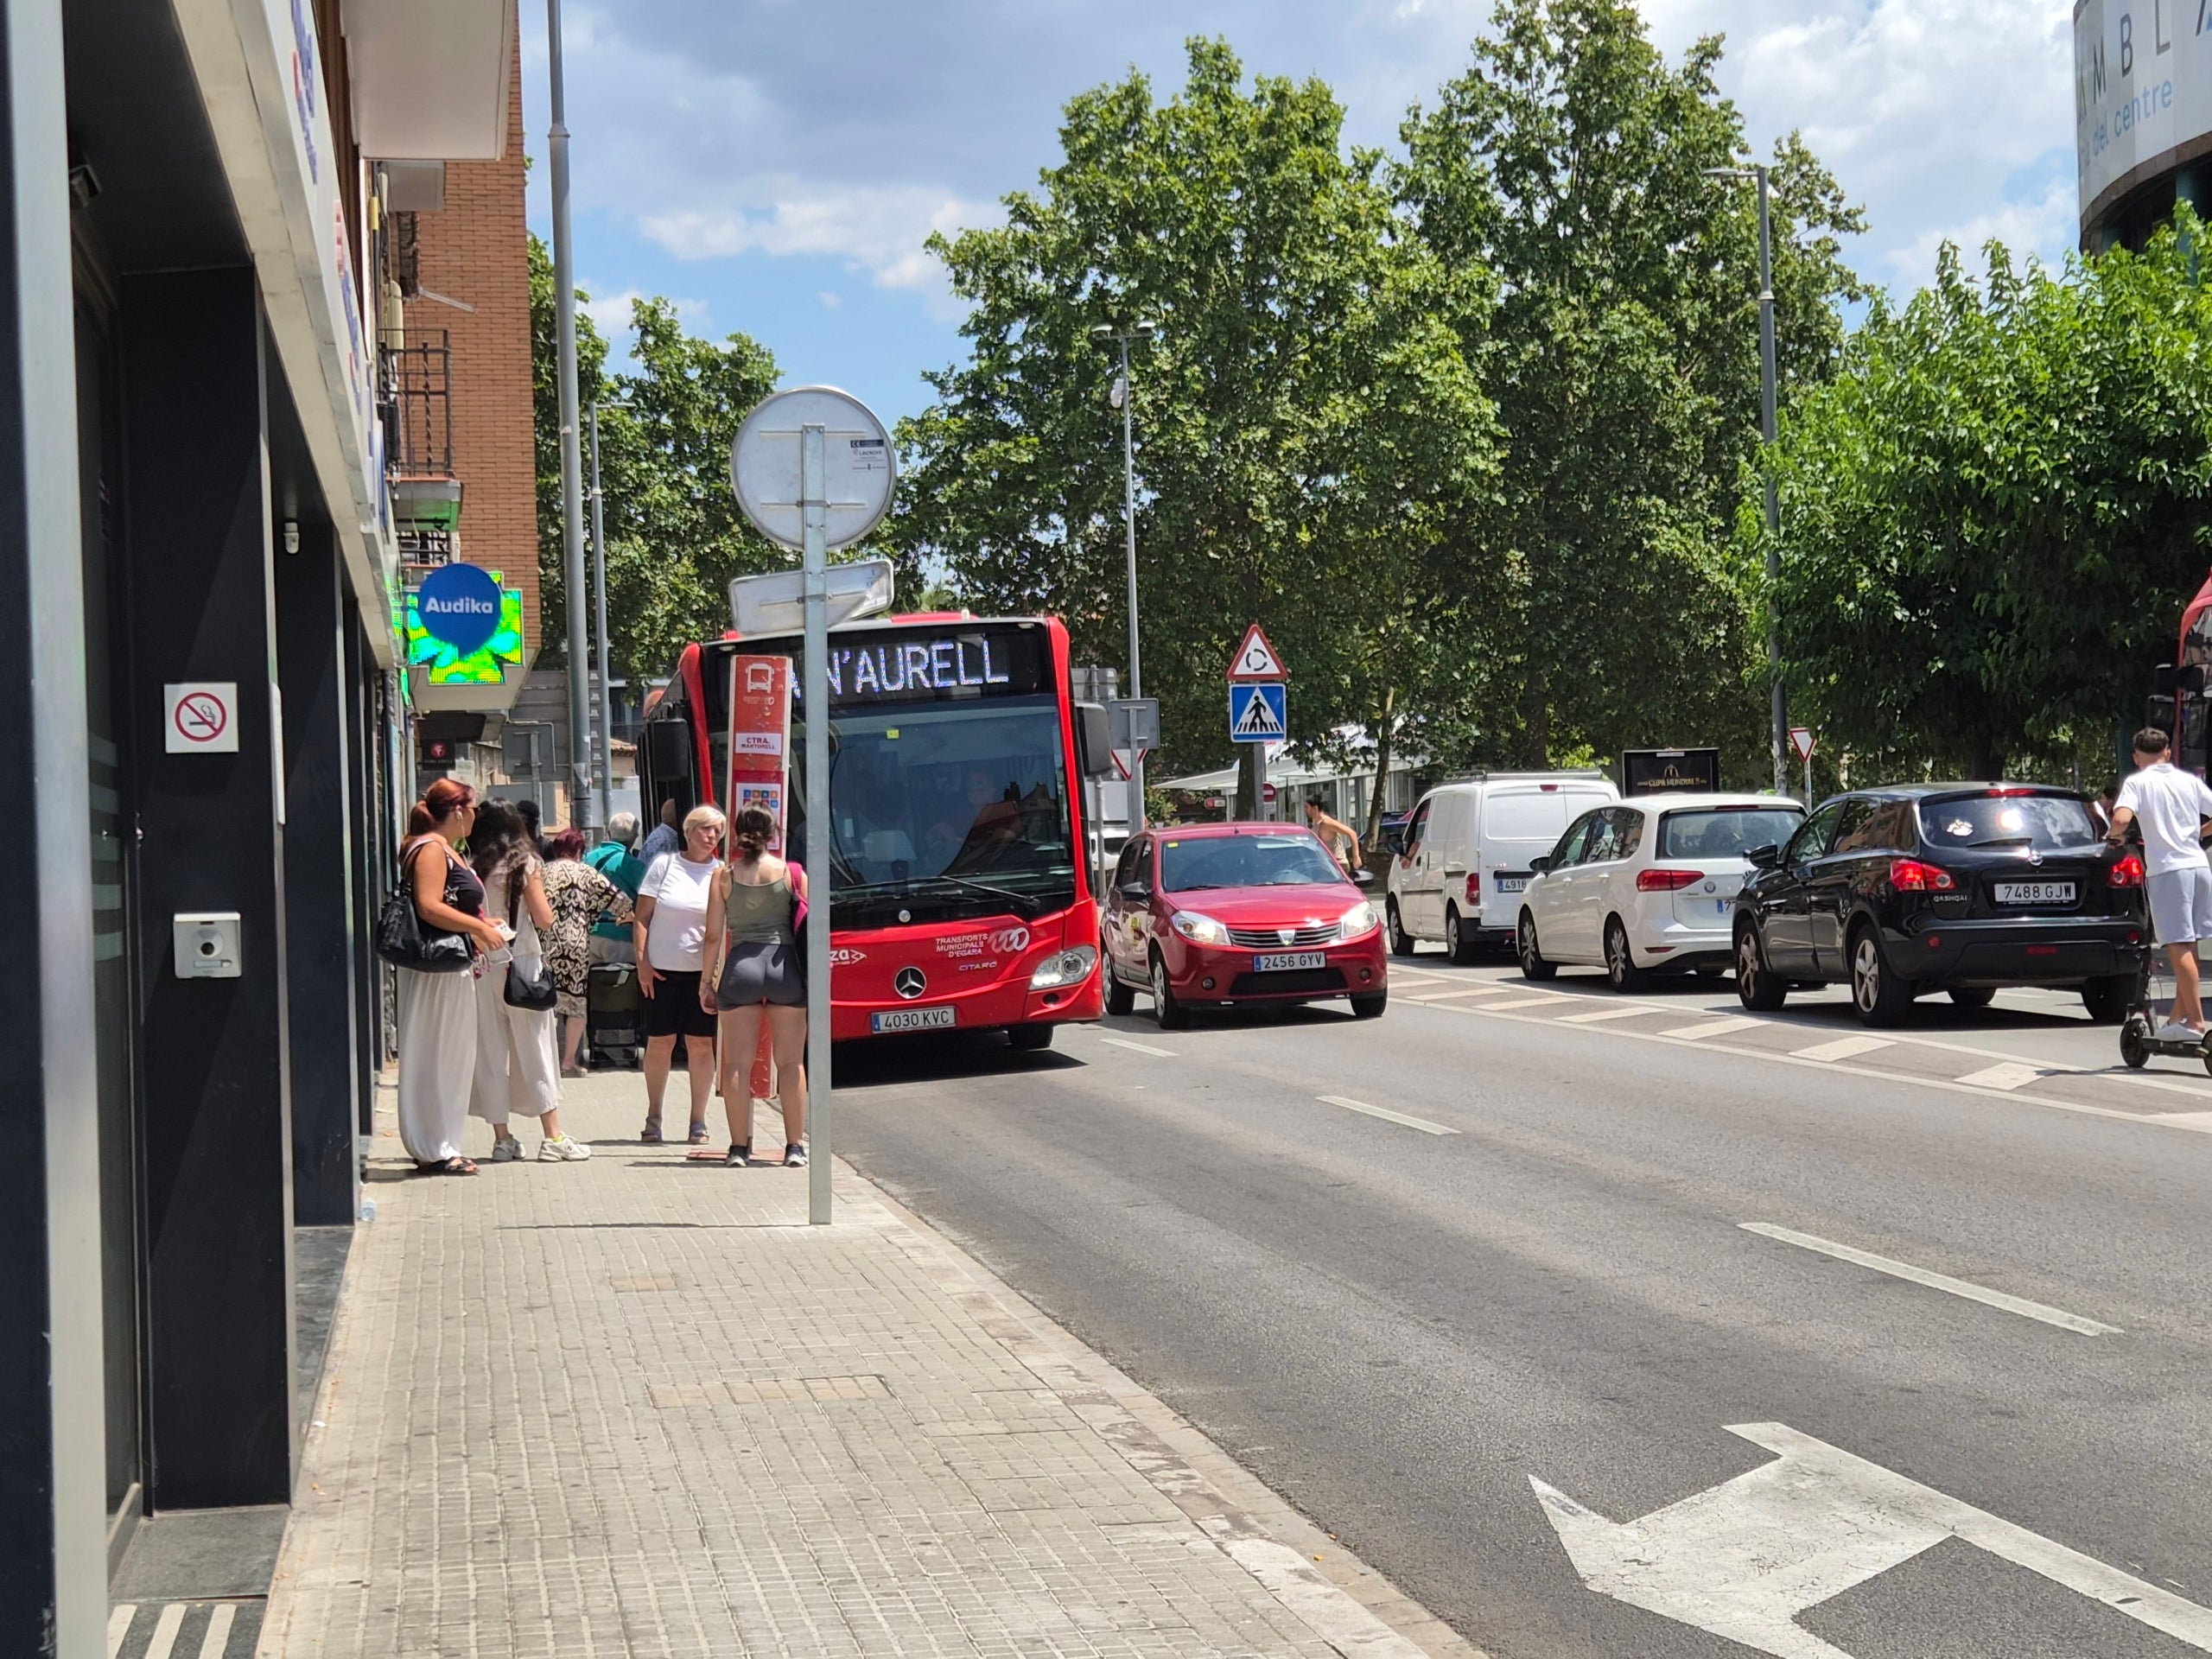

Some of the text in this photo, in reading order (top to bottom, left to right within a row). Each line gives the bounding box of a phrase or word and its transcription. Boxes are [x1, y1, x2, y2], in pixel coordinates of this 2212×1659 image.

[2114, 79, 2172, 138] centre
[425, 597, 493, 614] Audika
[2004, 885, 2072, 899] 7488 GJW
[936, 933, 988, 945] TRANSPORTS
[936, 940, 984, 952] MUNICIPALS
[1263, 954, 1322, 969] 2456 GYV
[884, 1010, 949, 1028] 4030 KVC
